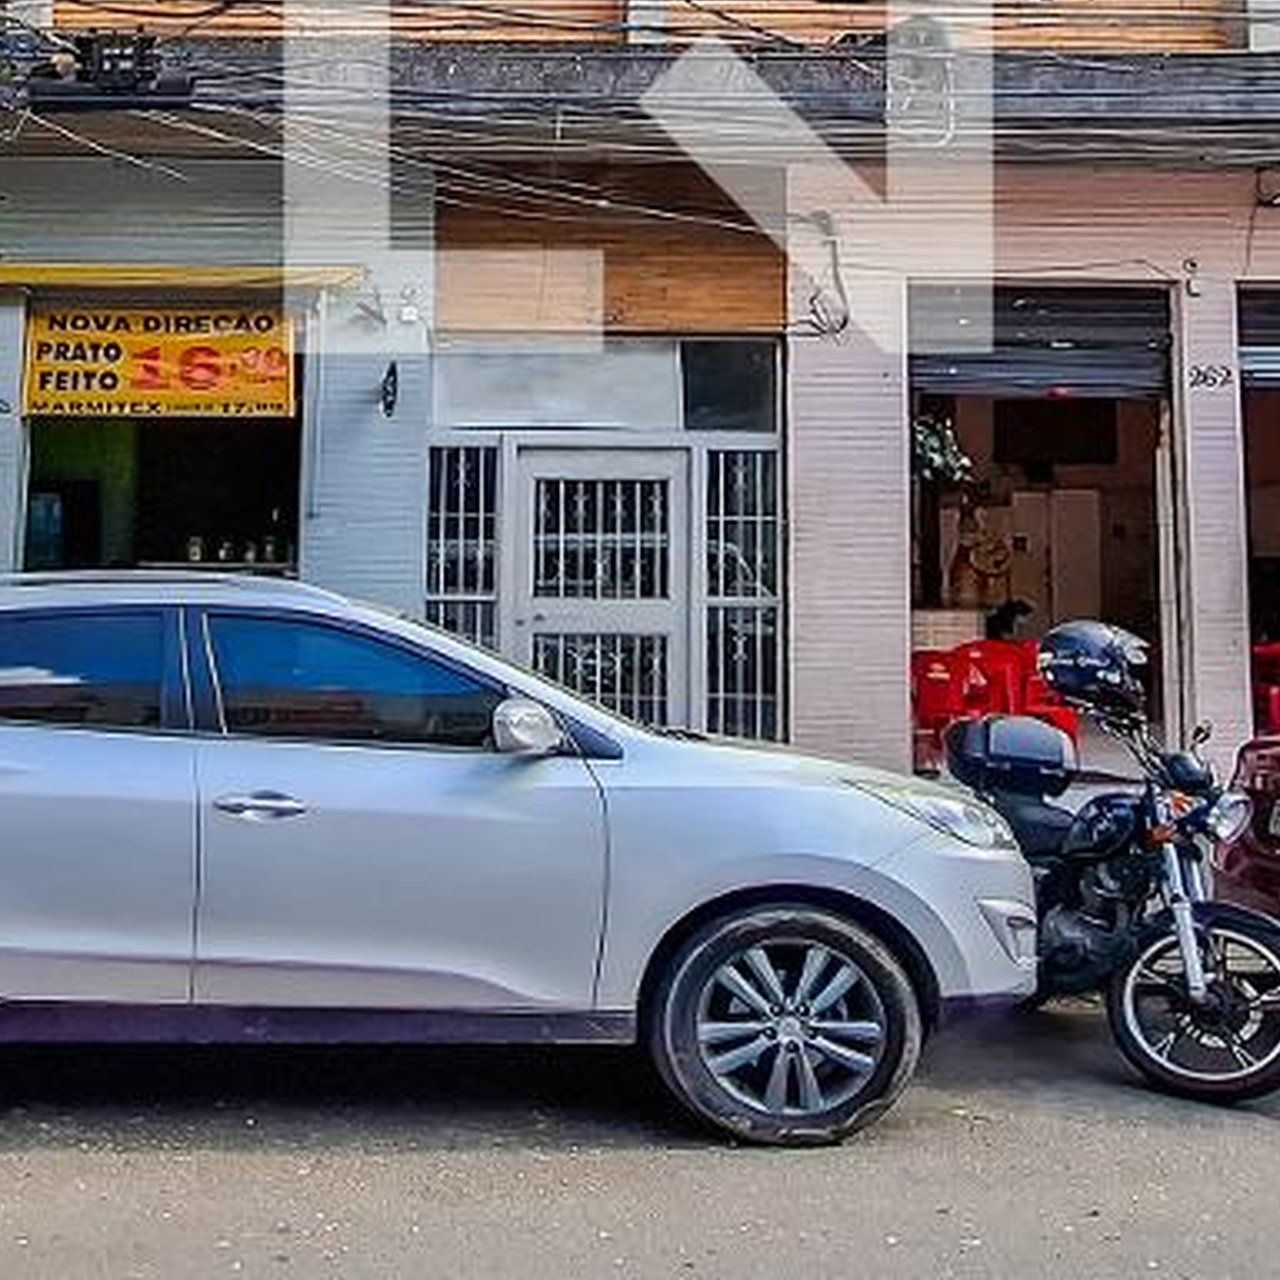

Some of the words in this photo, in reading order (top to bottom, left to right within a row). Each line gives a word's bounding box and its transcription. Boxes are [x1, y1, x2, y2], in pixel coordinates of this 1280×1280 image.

[48, 314, 131, 331] NOVA
[36, 342, 122, 363] PRATO
[38, 371, 120, 391] FEITO
[31, 400, 162, 416] MARMITEX
